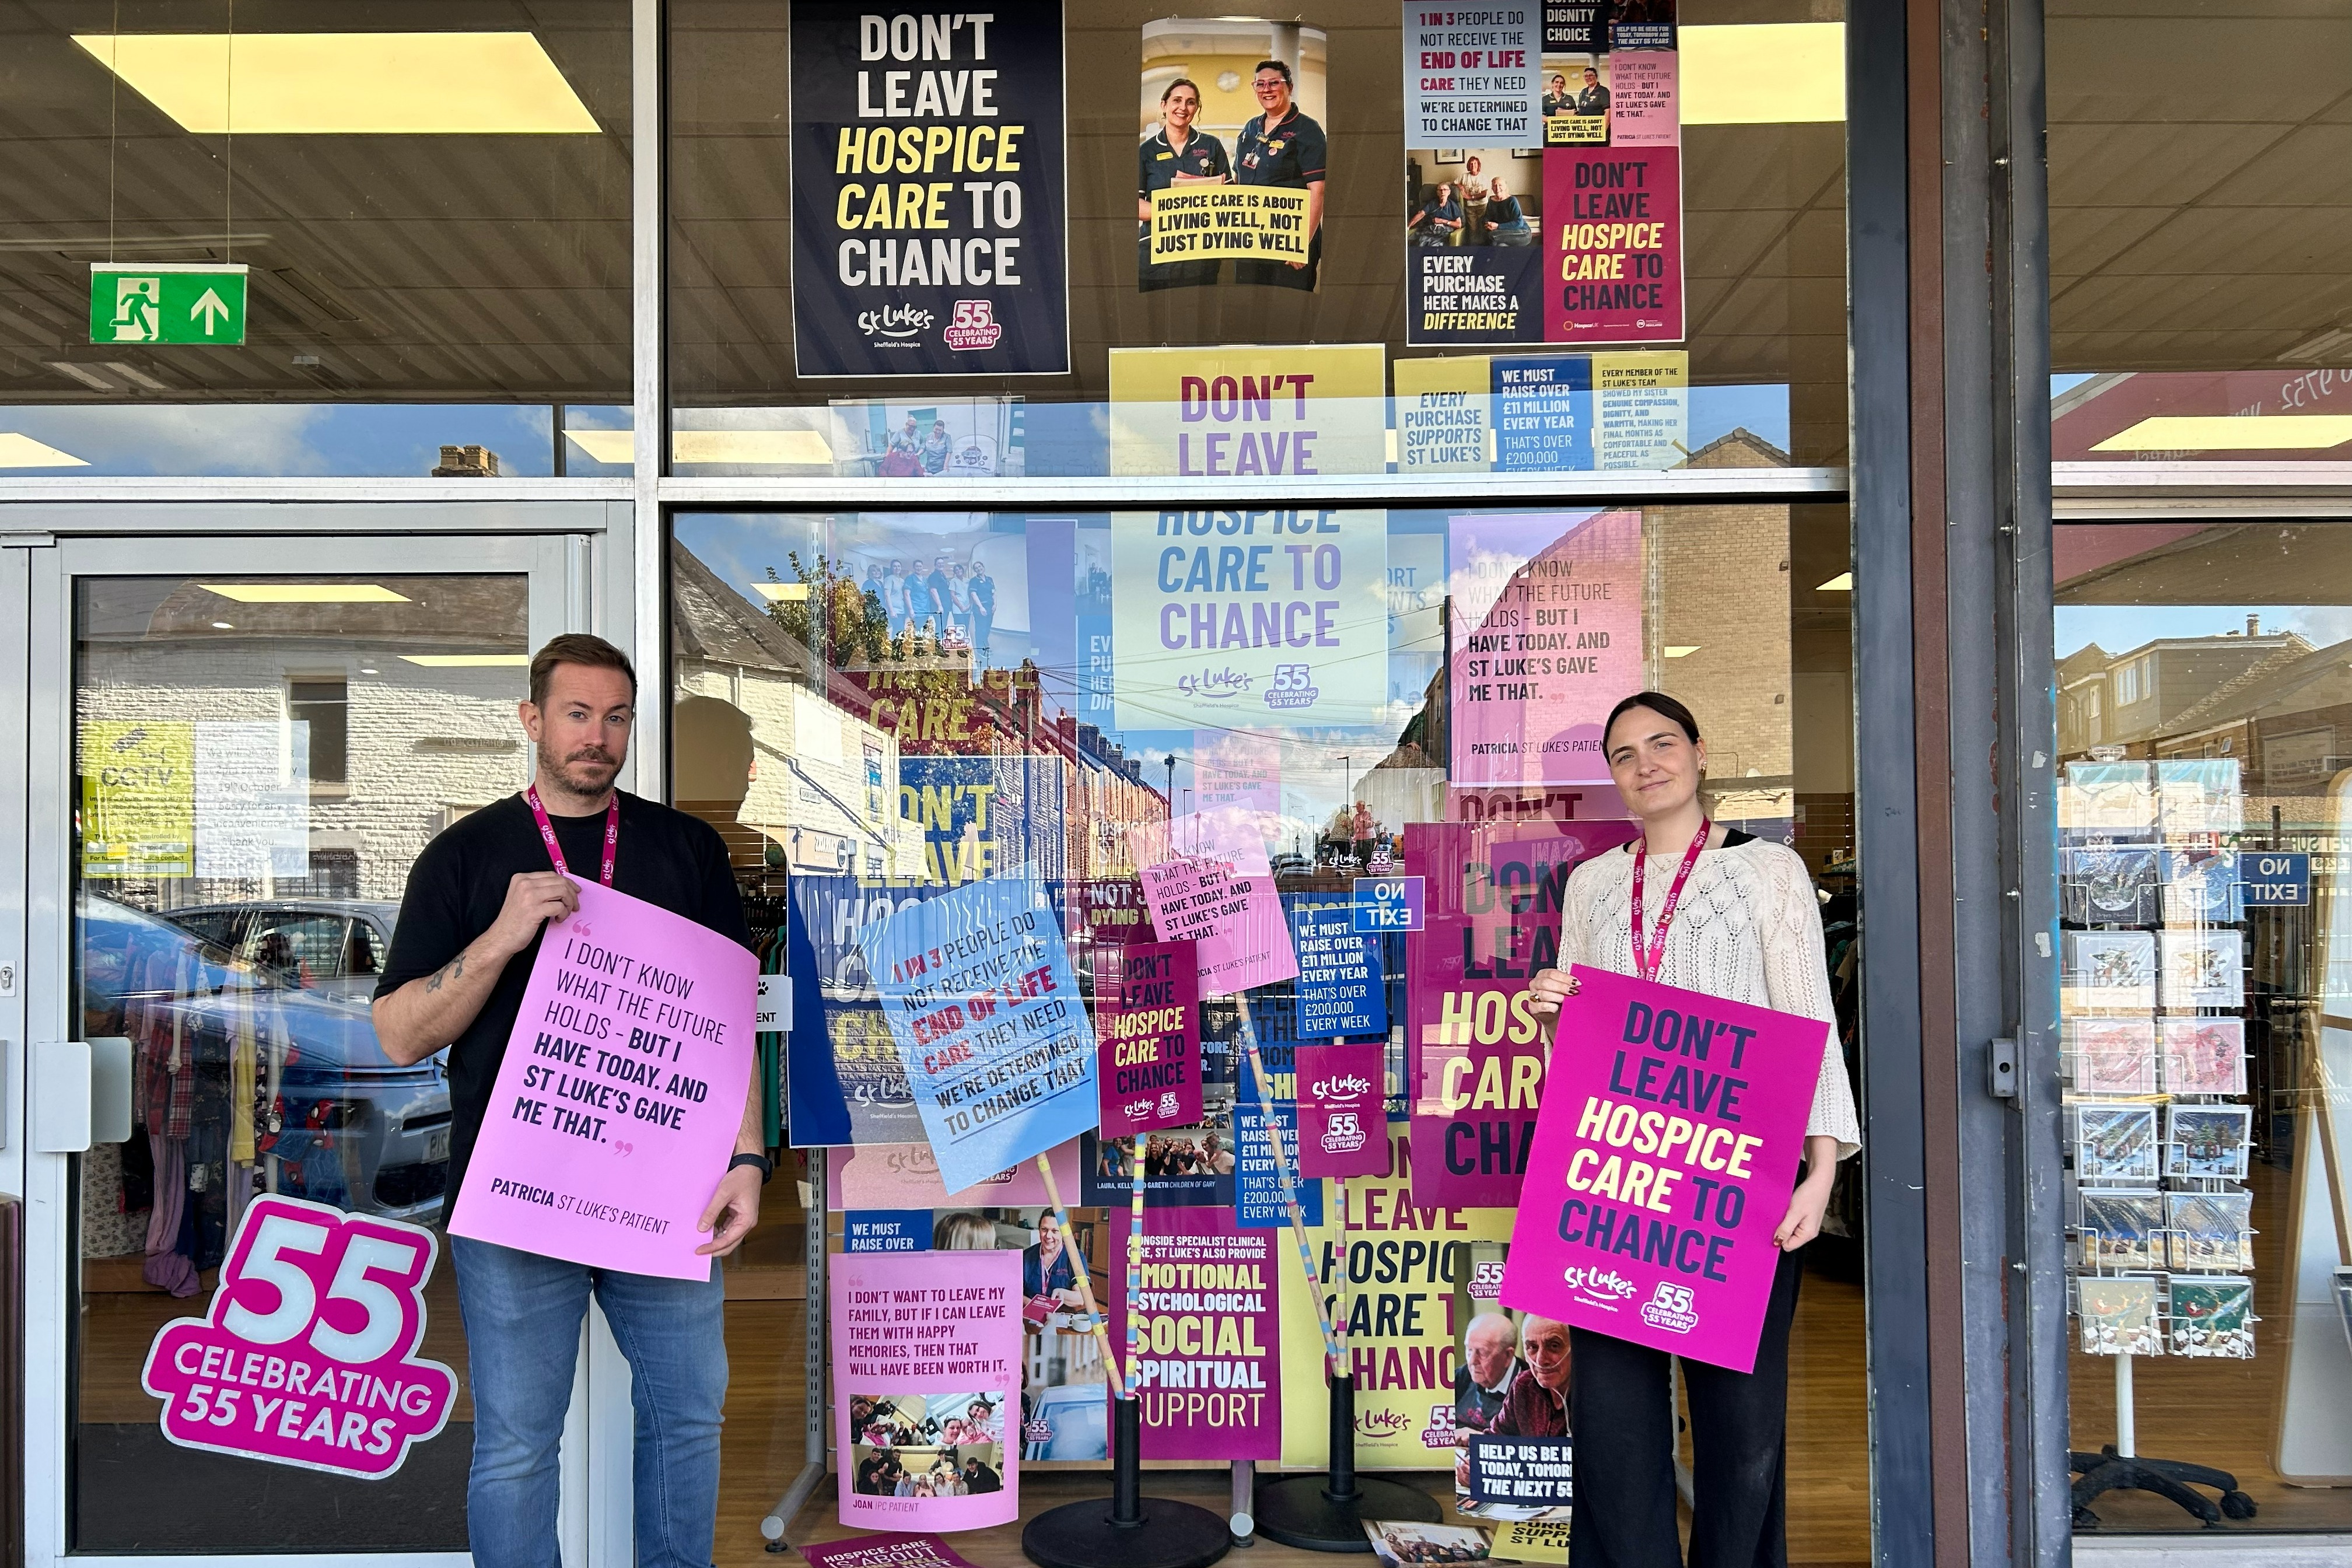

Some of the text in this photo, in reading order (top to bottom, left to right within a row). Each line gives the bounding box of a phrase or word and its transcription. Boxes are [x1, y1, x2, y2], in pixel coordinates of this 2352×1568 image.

[1420, 12, 1524, 26] 1 IN 3 PEOPLE DO
[1547, 9, 1595, 22] DIGNITY
[860, 14, 993, 61] DON'T
[1420, 32, 1524, 46] NOT RECEIVE THE
[1547, 29, 1590, 41] CHOICE
[1420, 50, 1525, 69] END OF LIFE
[1420, 76, 1526, 90] CARE THEY NEED
[858, 70, 998, 117] LEAVE
[1421, 101, 1527, 113] WE'RE DETERMINED
[1421, 118, 1527, 131] TO CHANGE THAT
[836, 126, 1024, 174] HOSPICE
[836, 181, 1021, 230] CARE TO
[1158, 194, 1303, 211] HOSPICE CARE IS ABOUT
[1158, 212, 1302, 232] LIVING WELL, NOT
[1156, 232, 1304, 254] JUST DYING WELL
[838, 238, 1020, 286] CHANCE
[1423, 256, 1473, 273] EVERY
[1423, 276, 1504, 293] PURCHASE
[1423, 295, 1518, 311] HERE MAKES A
[858, 303, 934, 335] St Luke's
[955, 303, 991, 328] 55
[1423, 313, 1517, 330] DIFFERENCE
[949, 328, 997, 337] CELEBRATING
[965, 336, 992, 345] YEARS
[1602, 369, 1623, 377] EVERY
[1625, 368, 1652, 376] MEMBER
[1665, 368, 1678, 376] THE
[1420, 391, 1466, 408] EVERY
[1405, 410, 1482, 428] PURCHASE
[1406, 428, 1482, 446] SUPPORTS
[1408, 446, 1481, 465] ST LUKE'S
[102, 767, 173, 787] CCTV
[1299, 923, 1348, 937] WE MUST
[1300, 937, 1363, 952] RAISE OVER
[1301, 952, 1363, 967] £11 MILLION
[564, 939, 694, 999] I DON'T KNOW
[1302, 967, 1368, 982] EVERY YEAR
[1303, 985, 1366, 1000] THAT'S OVER
[556, 969, 726, 1045] WHAT THE FUTURE
[1305, 1001, 1353, 1016] £200,000
[544, 1001, 612, 1040] HOLDS
[628, 1028, 670, 1058] BUT
[672, 1041, 682, 1062] I
[1306, 1015, 1370, 1031] EVERY WEEK
[1622, 1001, 1756, 1069] DON'T
[533, 1032, 708, 1103] HAVE TODAY. AND
[1608, 1051, 1748, 1122] LEAVE
[524, 1065, 686, 1130] ST LUKE'S GAVE
[512, 1097, 607, 1143] ME THAT.
[1575, 1096, 1763, 1180] HOSPICE
[1566, 1149, 1745, 1228] CARE TO
[491, 1178, 670, 1235] PATRICIA ST LUKE'S PATIENT
[1127, 1236, 1266, 1246] AONGSIDE SPECIALIST CLINICAL
[1558, 1199, 1734, 1282] CHANCE
[1156, 1248, 1167, 1258] ST
[1169, 1248, 1200, 1258] LUKE'S
[1203, 1248, 1226, 1258] ALSO
[1228, 1248, 1266, 1258] PROVIDE
[223, 1214, 417, 1364] 55
[848, 1287, 1005, 1303] I DON'T WANT TO LEAVE MY
[1126, 1293, 1266, 1311] SYCHOLOGICAL
[848, 1306, 1005, 1322] FAMILY, BUT IF I CAN LEAVE
[849, 1325, 954, 1340] THEM WITH HAPPY
[849, 1342, 978, 1359] MEMORIES, THEN THAT
[850, 1360, 1007, 1376] WILL HAVE BEEN WORTH IT.
[174, 1342, 432, 1416] CELEBRATING
[180, 1384, 396, 1455] 55 YEARS
[853, 1499, 919, 1512] JOAN IPC PATIENT
